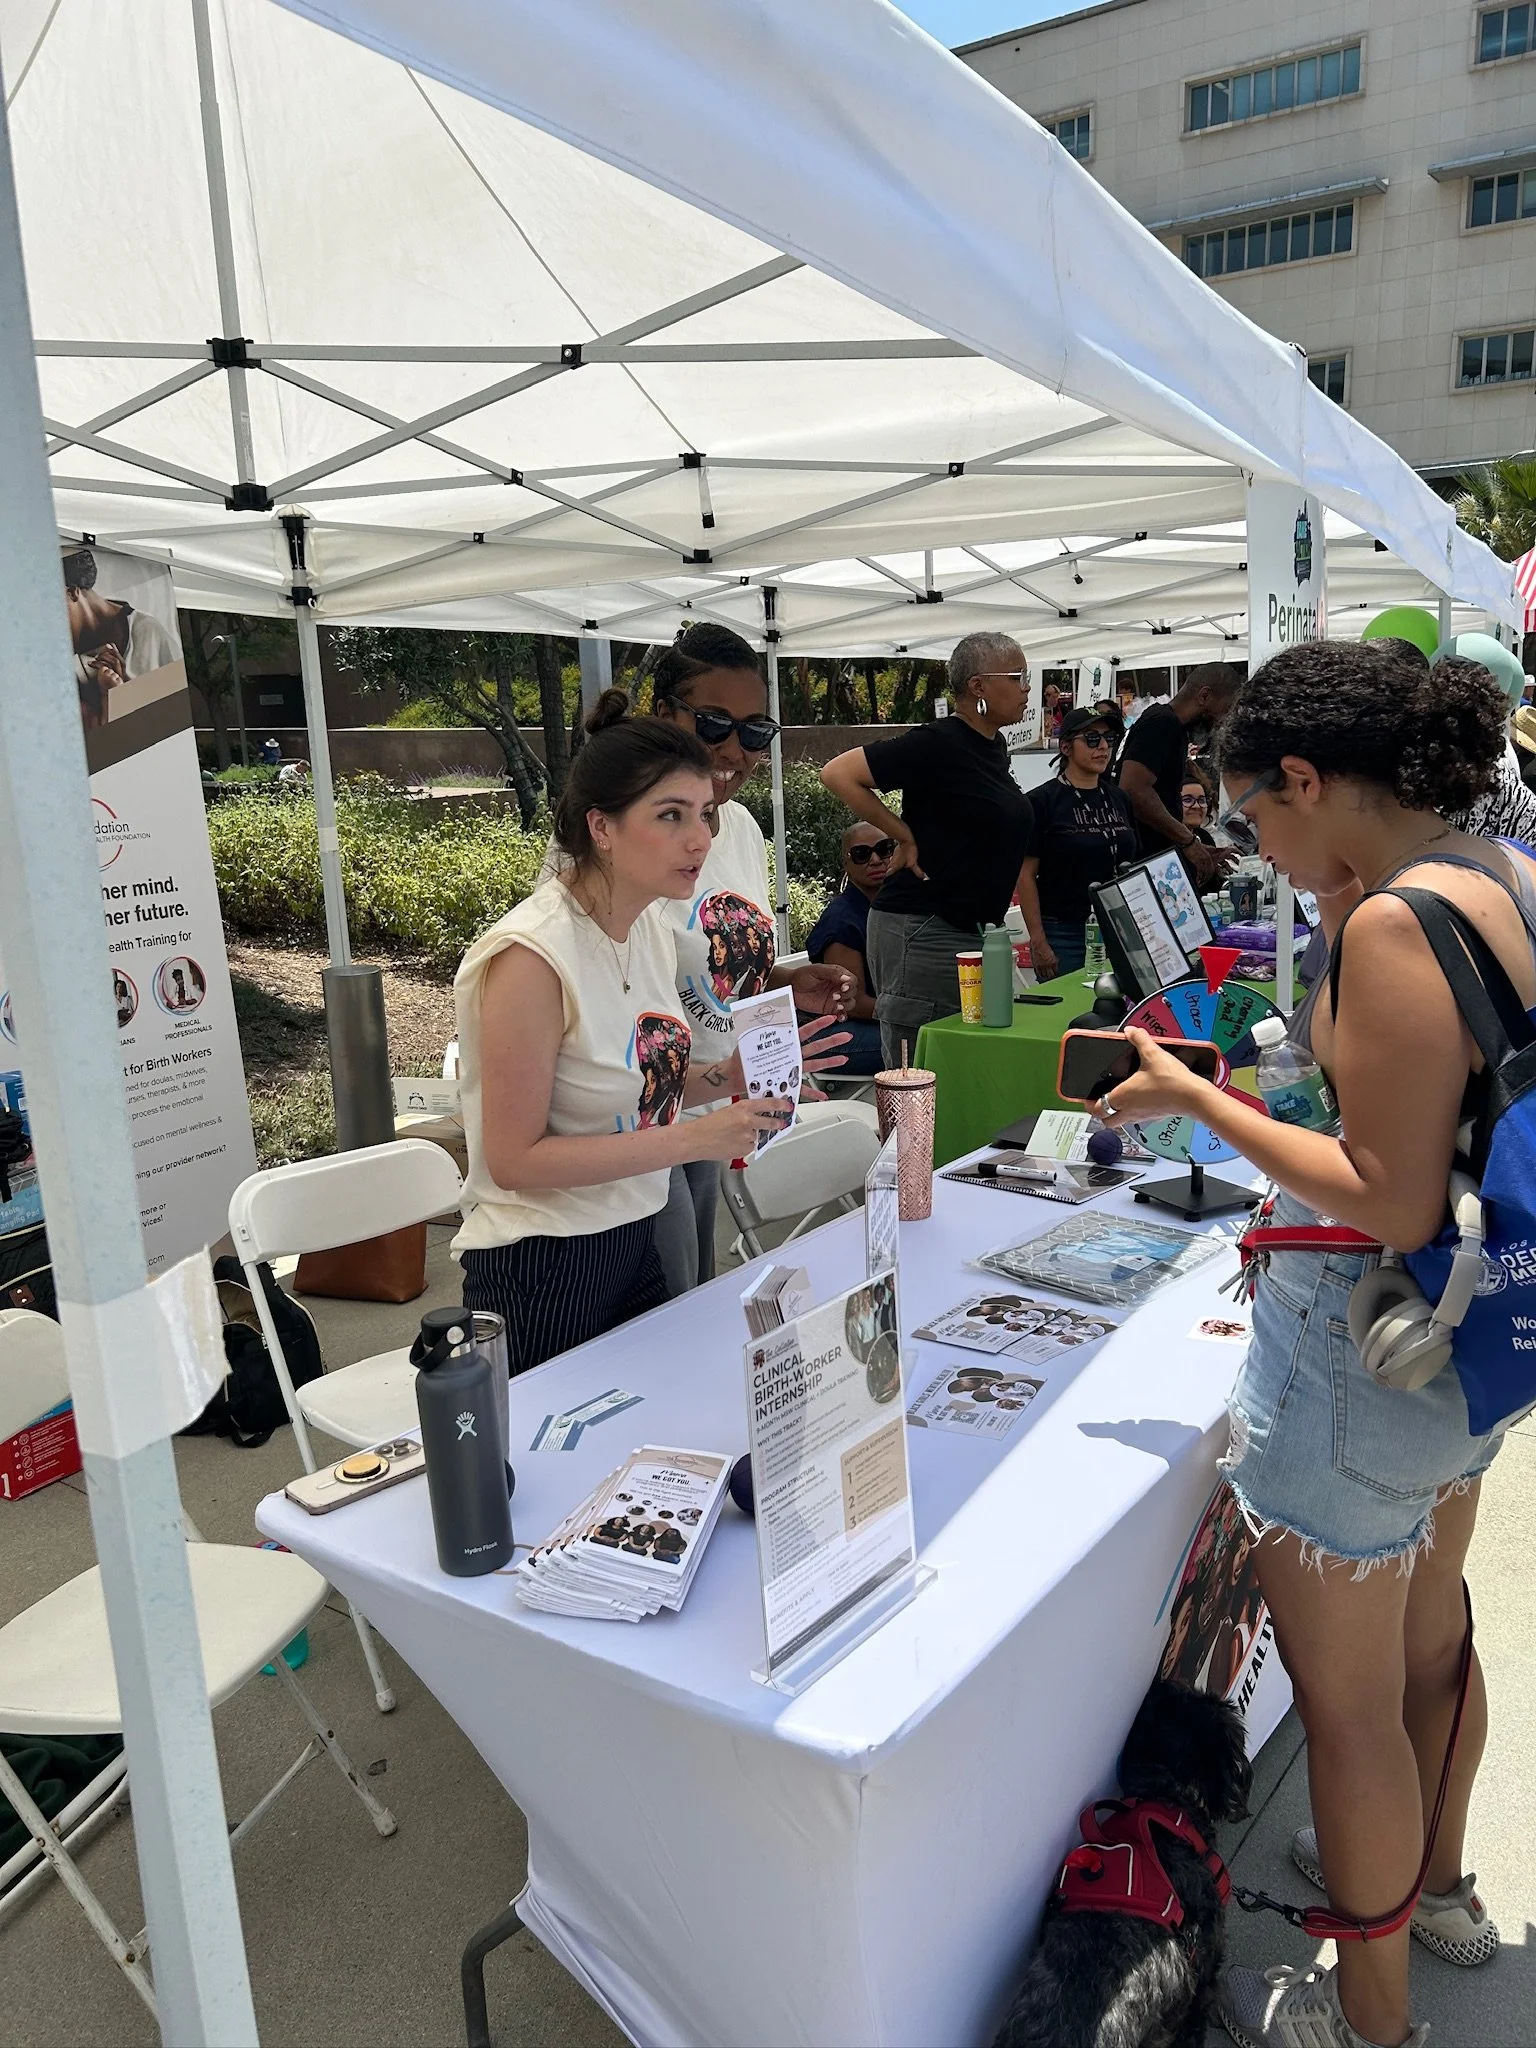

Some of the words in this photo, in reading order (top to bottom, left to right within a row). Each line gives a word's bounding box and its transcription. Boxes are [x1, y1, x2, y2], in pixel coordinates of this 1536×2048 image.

[1269, 593, 1318, 642] Perinatal
[1007, 728, 1032, 747] Centers
[111, 832, 151, 842] FOUNDATION
[132, 876, 179, 897] mind.
[134, 903, 189, 922] future.
[135, 934, 177, 949] Training
[178, 930, 192, 941] for
[678, 988, 711, 1022] BLACK
[704, 1014, 728, 1033] GIRLS
[165, 1024, 213, 1041] PROFESSIONALS
[174, 1018, 201, 1029] MEDICAL
[130, 1063, 144, 1075] for
[146, 1056, 170, 1071] Birth
[171, 1047, 212, 1064] Workers
[140, 1079, 149, 1089] for
[150, 1074, 175, 1086] doulas,
[175, 1066, 208, 1079] midwives,
[182, 1081, 187, 1090] &
[188, 1078, 206, 1088] more
[131, 1107, 159, 1121] process
[159, 1104, 171, 1112] the
[172, 1094, 204, 1107] emotional
[155, 1134, 165, 1142] on
[165, 1126, 188, 1138] mental
[189, 1117, 217, 1131] wellness
[152, 1165, 164, 1175] our
[165, 1155, 195, 1171] provider
[195, 1144, 227, 1160] network?
[26, 1209, 41, 1219] Pad
[753, 1351, 806, 1389] CLINICAL
[754, 1346, 842, 1406] BIRTH-WORKER
[755, 1373, 823, 1422] INTERNSHIP
[756, 1417, 780, 1435] 9-MONTH
[794, 1396, 816, 1411] CLINICAL
[820, 1382, 837, 1396] DOULA
[836, 1369, 859, 1385] TRAINING
[757, 1438, 771, 1448] WHY
[771, 1429, 783, 1440] THIS
[782, 1416, 802, 1433] TRACK?
[761, 1484, 787, 1505] PROGRAM
[787, 1465, 816, 1488] STRUCTURE
[847, 1472, 853, 1485] 1
[848, 1495, 856, 1509] 2
[849, 1515, 857, 1530] 3
[464, 1547, 483, 1555] Hydro
[483, 1541, 498, 1551] Flask
